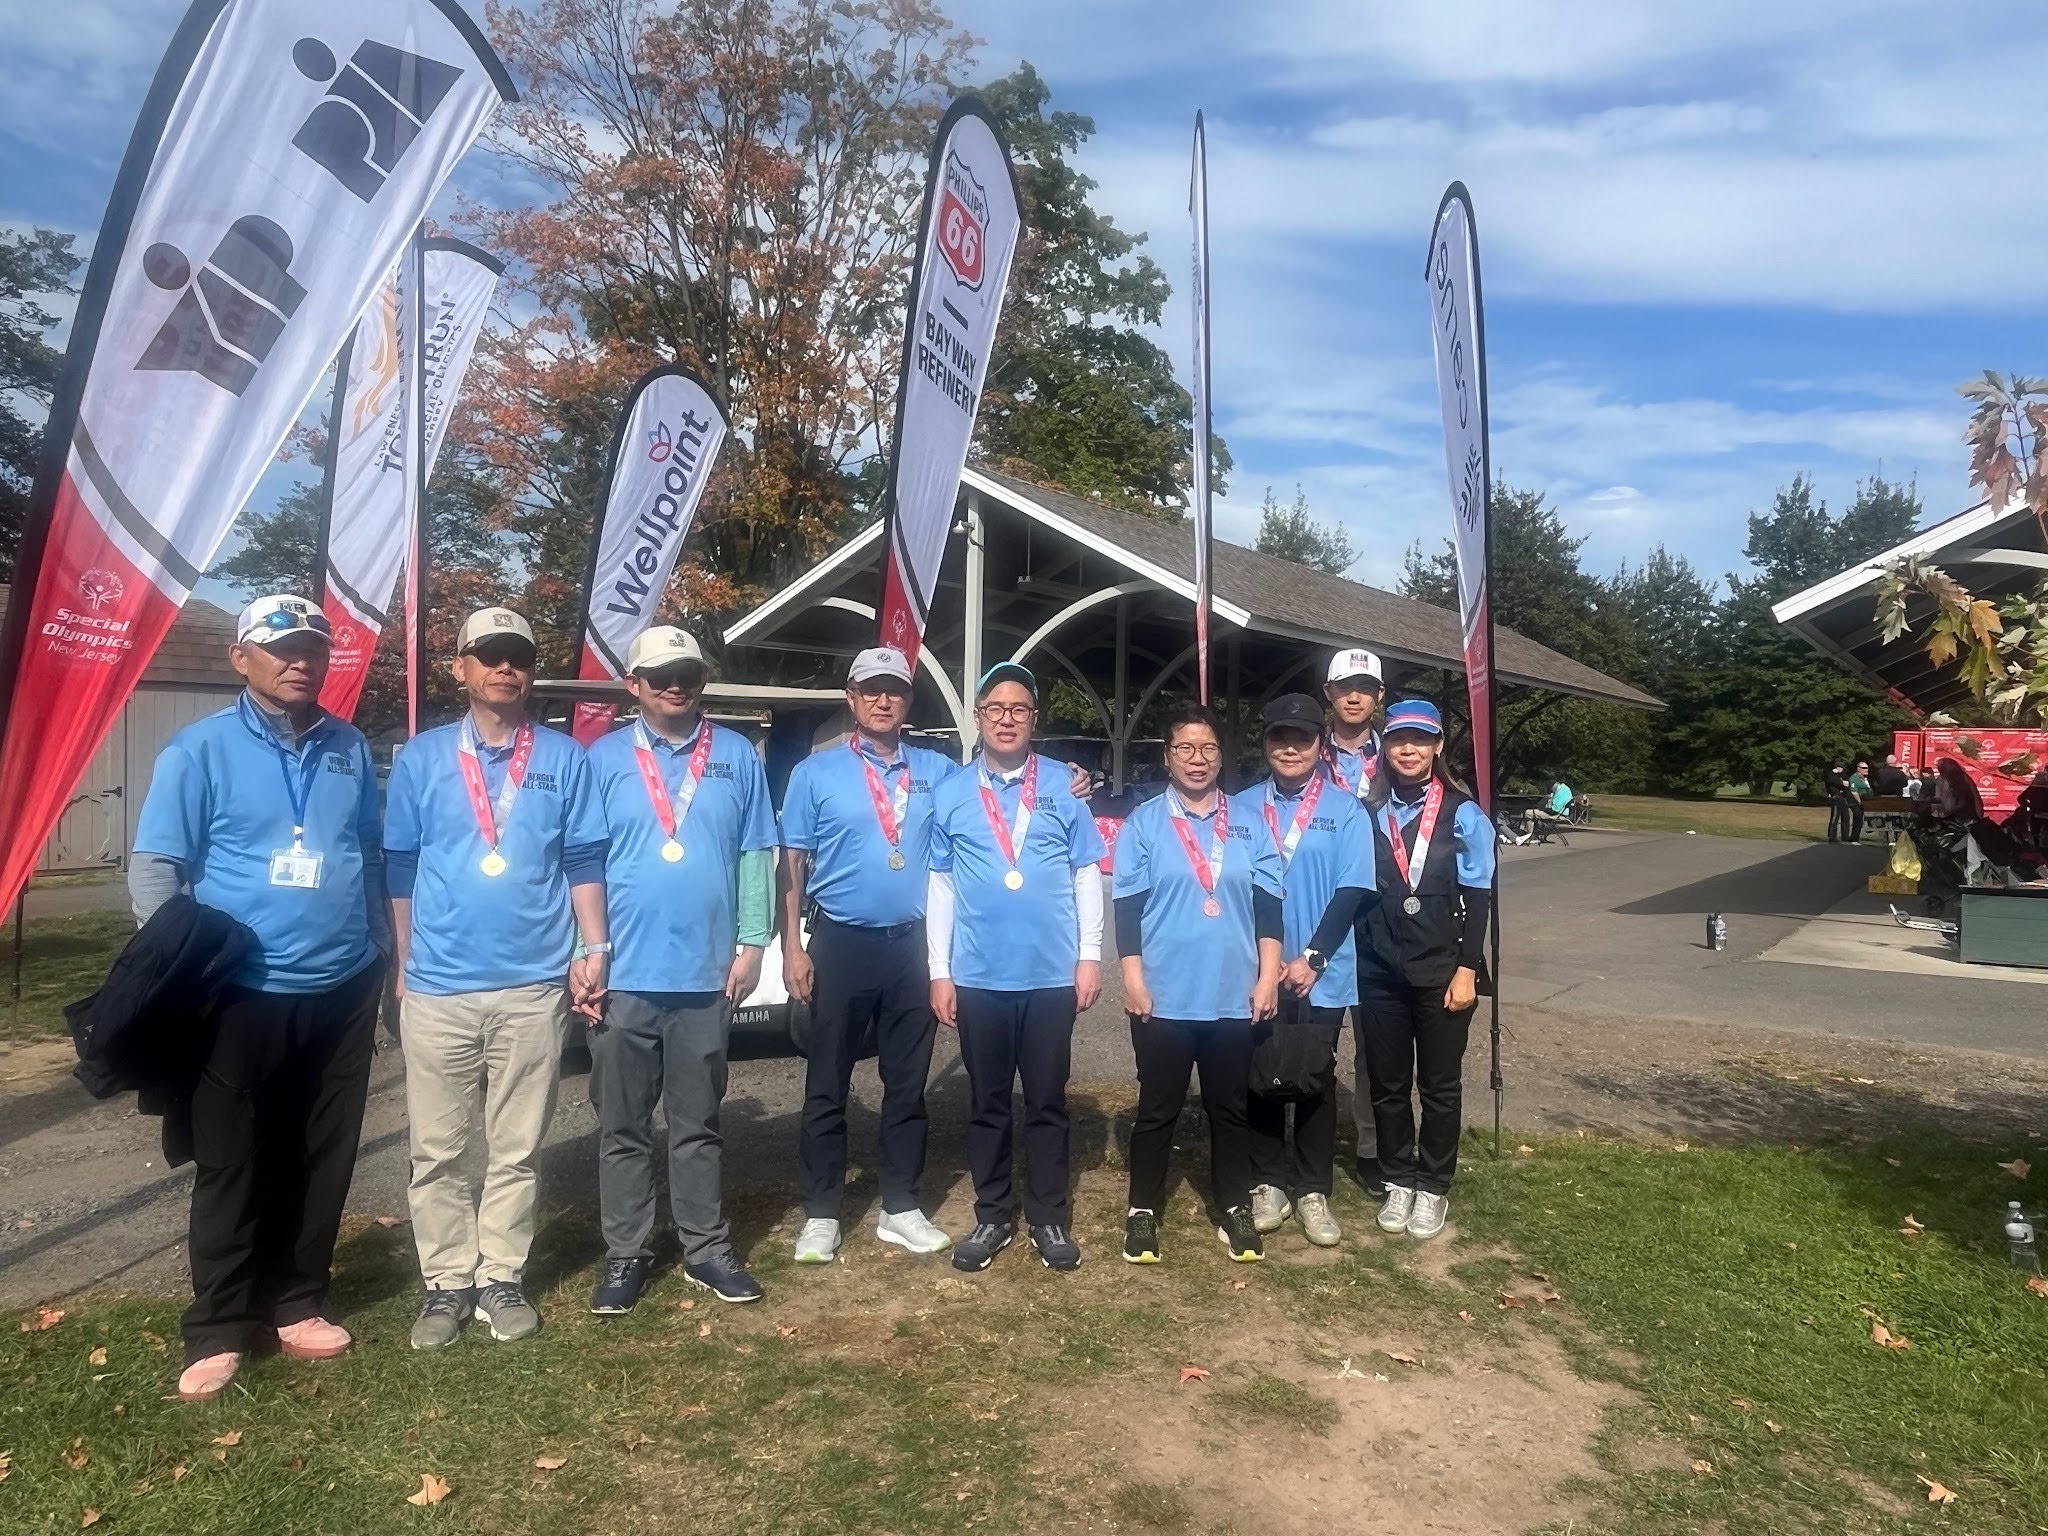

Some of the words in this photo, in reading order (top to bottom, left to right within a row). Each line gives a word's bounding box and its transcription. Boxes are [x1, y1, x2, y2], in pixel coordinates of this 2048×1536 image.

[947, 166, 985, 223] PHILLIPS
[946, 207, 979, 267] 66
[926, 311, 976, 381] BAYWAY
[919, 342, 977, 417] REFINERY
[606, 409, 709, 617] Wellpoint
[55, 607, 131, 632] Special
[42, 622, 134, 650] Olympics
[47, 640, 77, 655] New
[78, 647, 122, 665] Jersey
[521, 780, 558, 794] ALL-STARS
[527, 772, 556, 783] BERGEN
[732, 1010, 770, 1025] AMAHA
